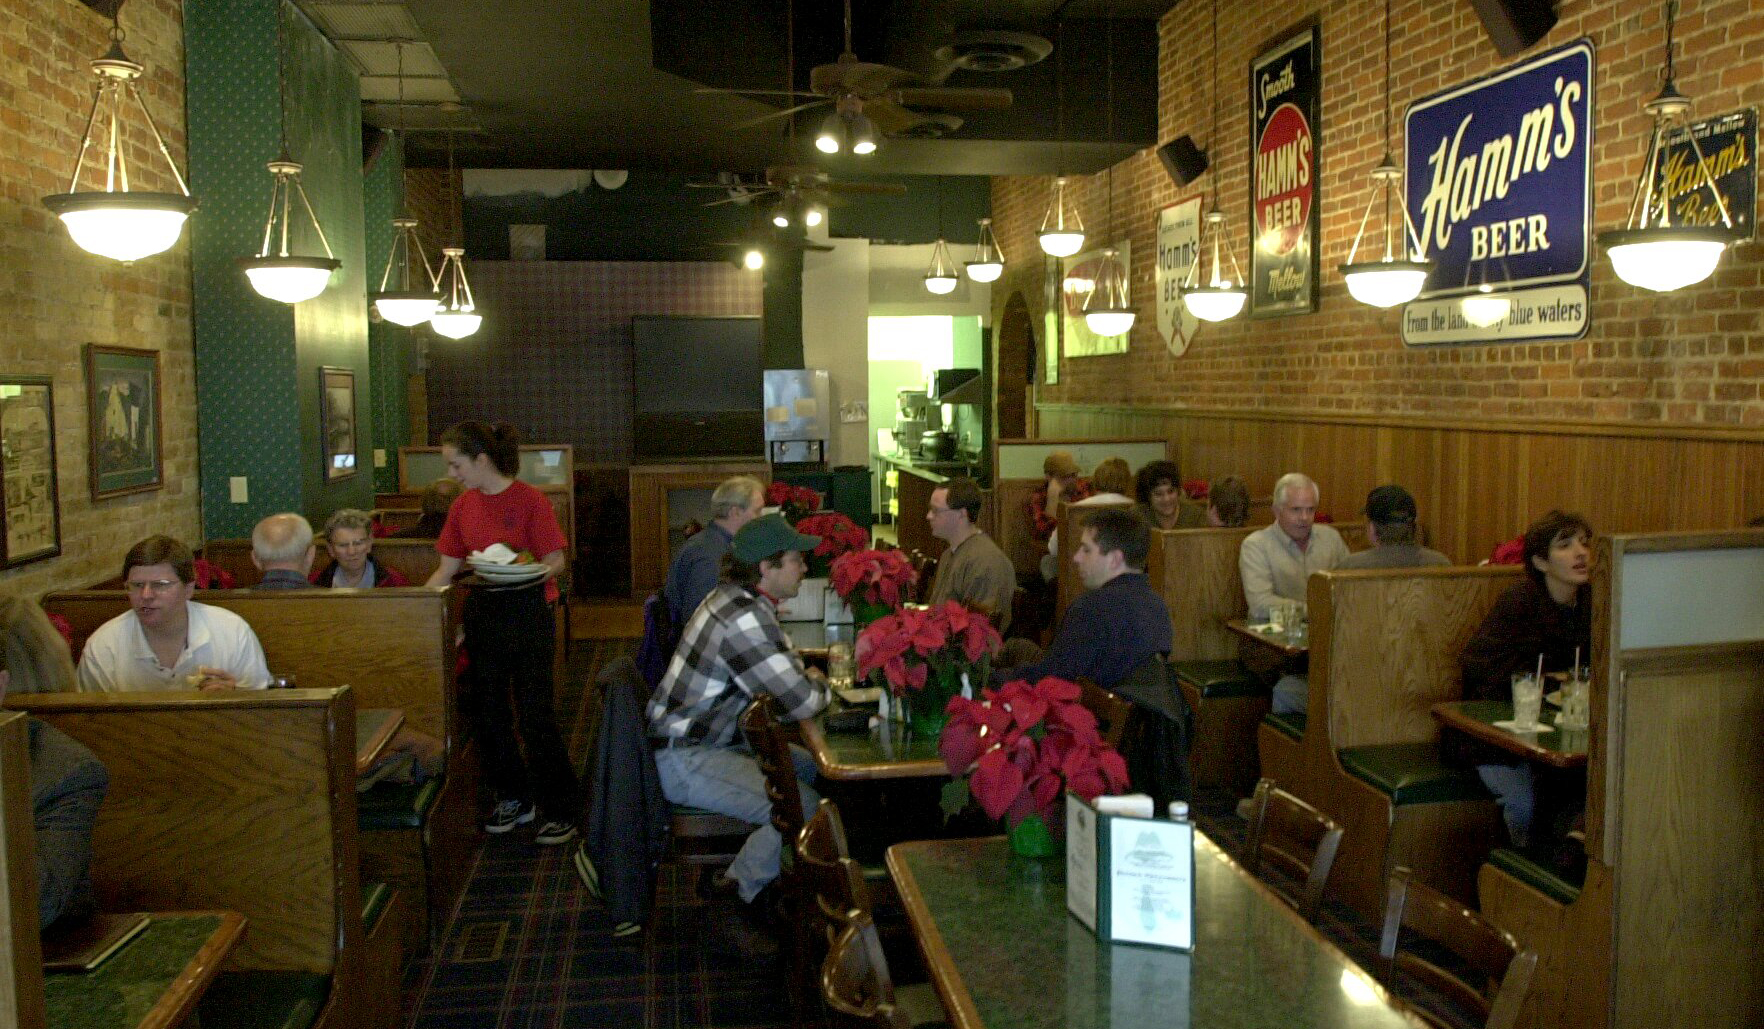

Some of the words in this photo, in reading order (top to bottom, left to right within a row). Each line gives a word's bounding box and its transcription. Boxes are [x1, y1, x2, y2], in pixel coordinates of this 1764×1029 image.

[1258, 60, 1295, 119] Smooth
[1258, 128, 1309, 201] HAMM'S
[1410, 76, 1581, 261] Hamm's
[1651, 132, 1750, 215] Hamm's
[1265, 197, 1301, 232] BEER
[1160, 236, 1198, 271] Hamm's
[1471, 214, 1550, 261] BEER
[1164, 276, 1189, 302] BEE
[1268, 266, 1305, 298] Mellow
[1407, 310, 1428, 333] From
[1431, 308, 1446, 331] the
[1509, 299, 1533, 325] blue
[1538, 298, 1582, 323] waters
